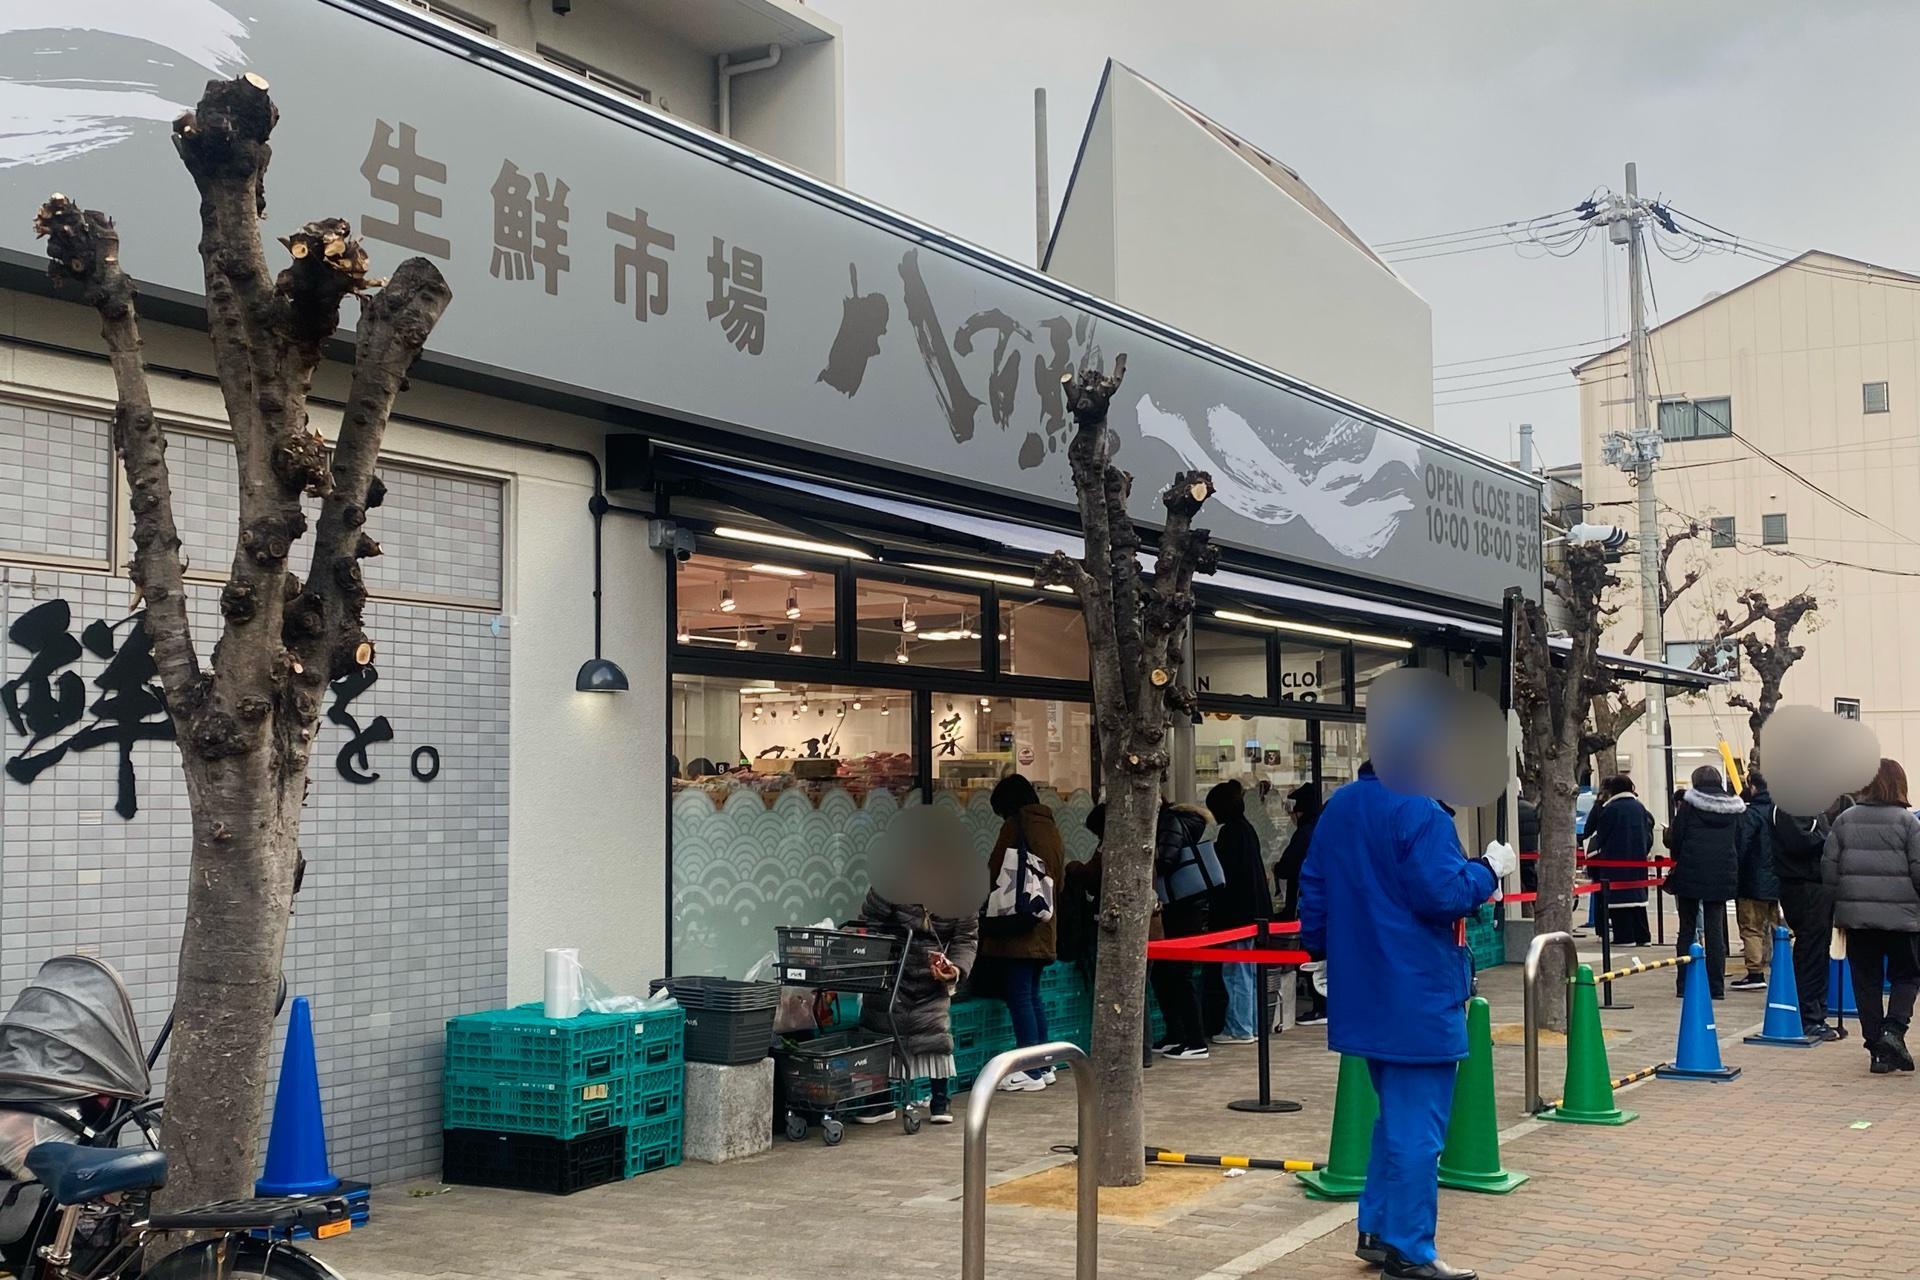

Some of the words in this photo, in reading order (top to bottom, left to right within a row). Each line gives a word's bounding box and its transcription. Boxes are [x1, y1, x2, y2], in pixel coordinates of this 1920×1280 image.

[360, 118, 768, 356] 生鮮市場
[1425, 463, 1464, 509] OPEN
[1472, 480, 1511, 525] CLOSE
[1516, 492, 1537, 533] 日曜
[1426, 505, 1469, 551] 10:00
[1474, 520, 1512, 563] 18:00
[1516, 532, 1539, 573] 定休
